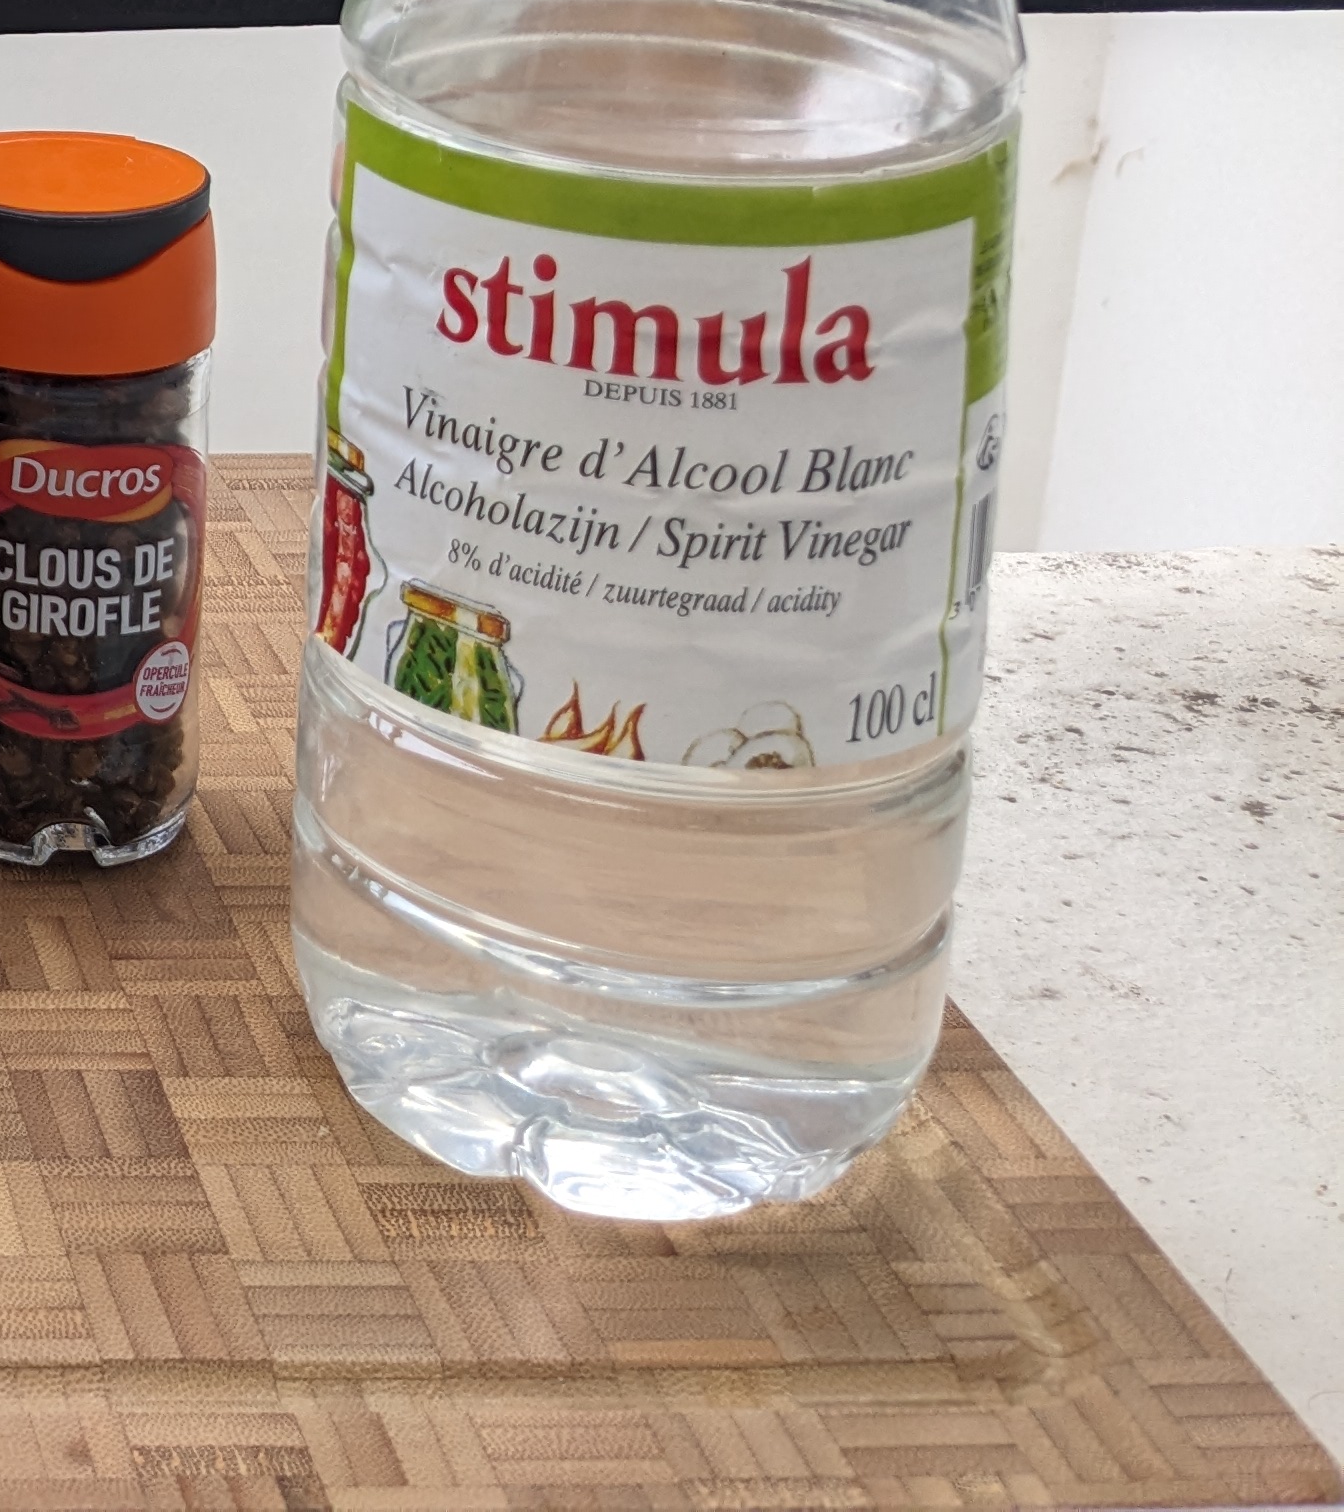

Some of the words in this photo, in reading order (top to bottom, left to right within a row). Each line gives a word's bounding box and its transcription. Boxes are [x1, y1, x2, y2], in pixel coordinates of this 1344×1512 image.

[436, 253, 878, 387] stimula
[583, 377, 683, 409] DEPUIS
[690, 389, 739, 411] 1881
[401, 383, 564, 475] Vinaigre
[797, 443, 916, 494] Blanc
[11, 456, 162, 498] Ducros
[393, 456, 621, 556] Alcoholazijn
[657, 515, 768, 568] Spirit
[777, 516, 914, 567] Vinegar
[134, 537, 175, 586] DE
[447, 536, 483, 572] 8%
[487, 554, 583, 596] d'acidité
[604, 582, 748, 617] zuurtegraad
[766, 586, 843, 618] acidity
[1, 589, 162, 637] GIROFLE
[142, 662, 188, 681] OPERCULE
[845, 683, 907, 744] 100
[911, 671, 939, 724] cl
